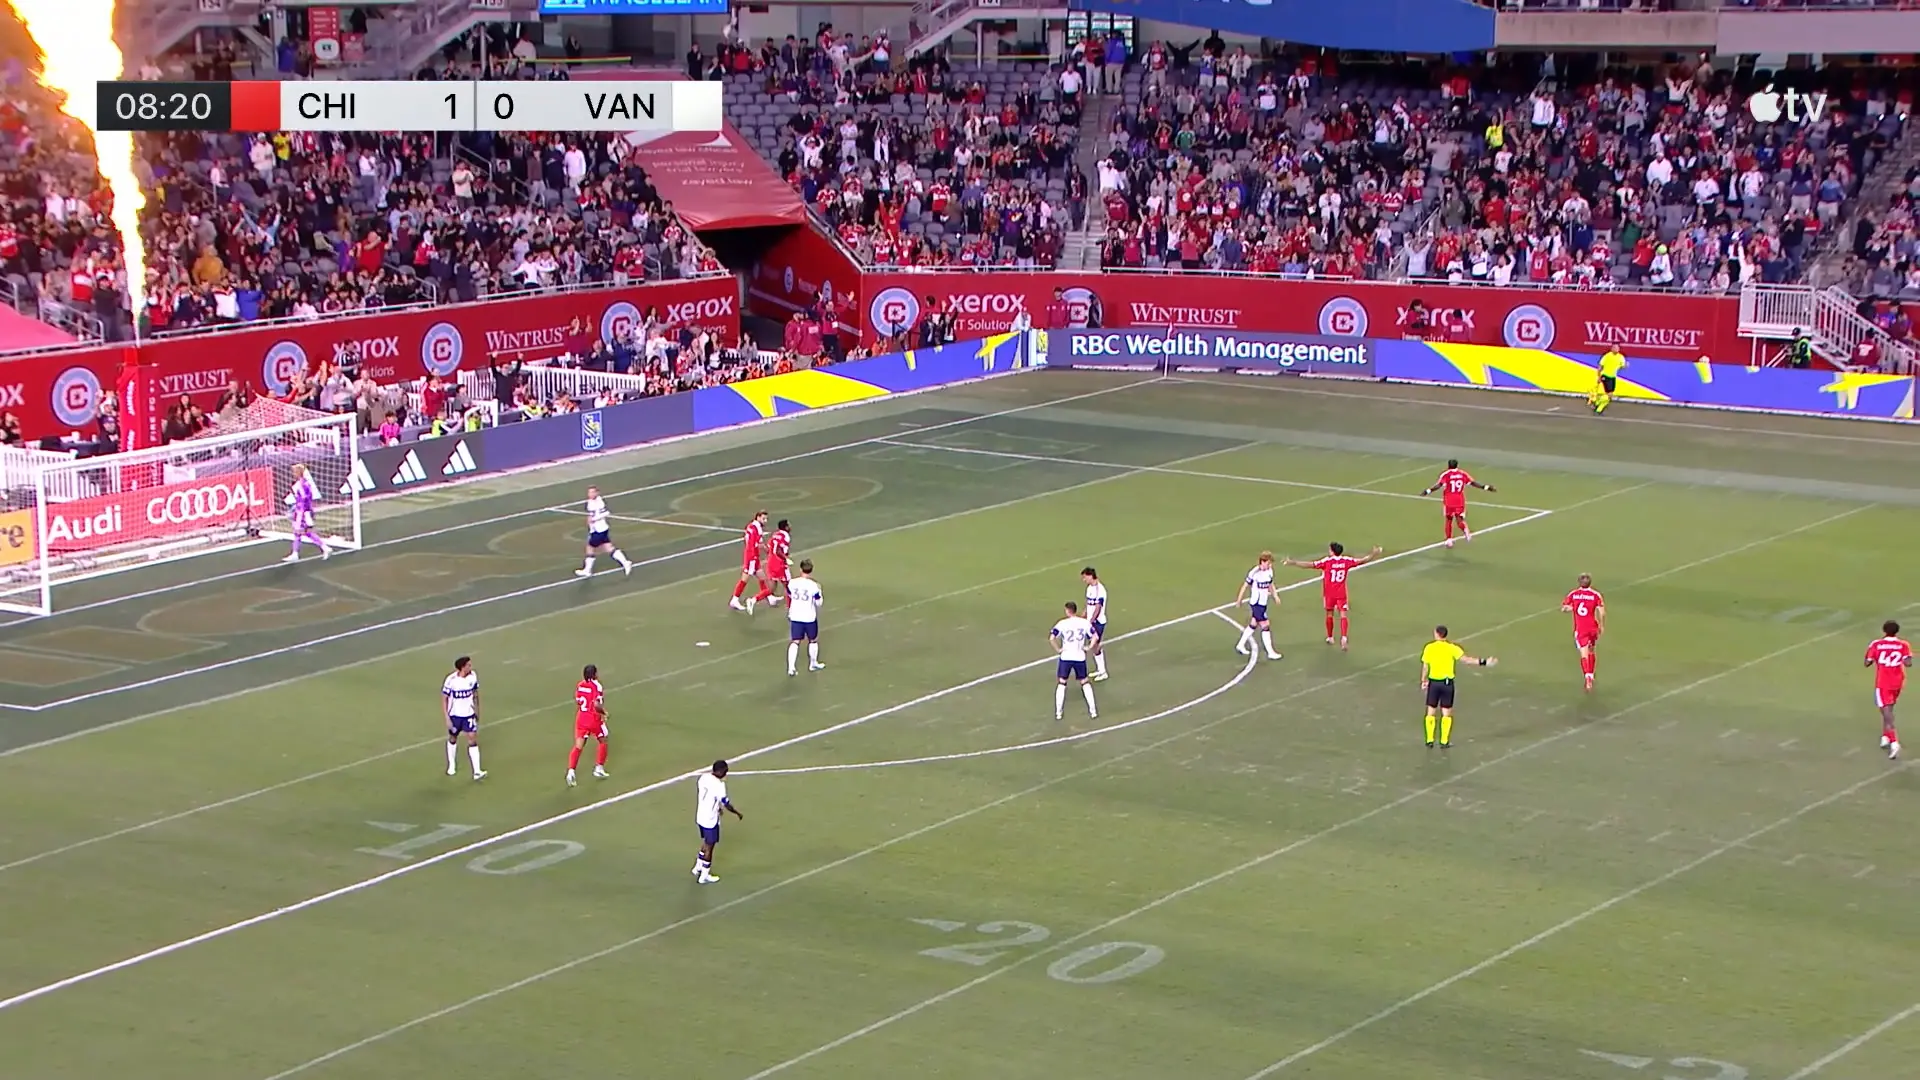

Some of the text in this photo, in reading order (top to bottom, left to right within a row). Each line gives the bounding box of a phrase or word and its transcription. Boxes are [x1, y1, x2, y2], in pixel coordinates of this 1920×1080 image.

[667, 296, 733, 322] xerox
[947, 294, 1026, 313] xerox
[1131, 302, 1238, 325] WINTRUST
[1584, 321, 1700, 346] WINTRUST
[1071, 335, 1120, 356] RBC
[1126, 333, 1208, 356] Wealth
[1215, 337, 1368, 366] Management
[584, 436, 602, 448] RBC
[1450, 480, 1464, 493] 19
[48, 505, 122, 544] Audi
[1330, 569, 1346, 583] 18
[793, 588, 809, 602] 33
[1577, 602, 1589, 616] 6
[1066, 628, 1085, 642] 23
[1878, 651, 1902, 667] 42
